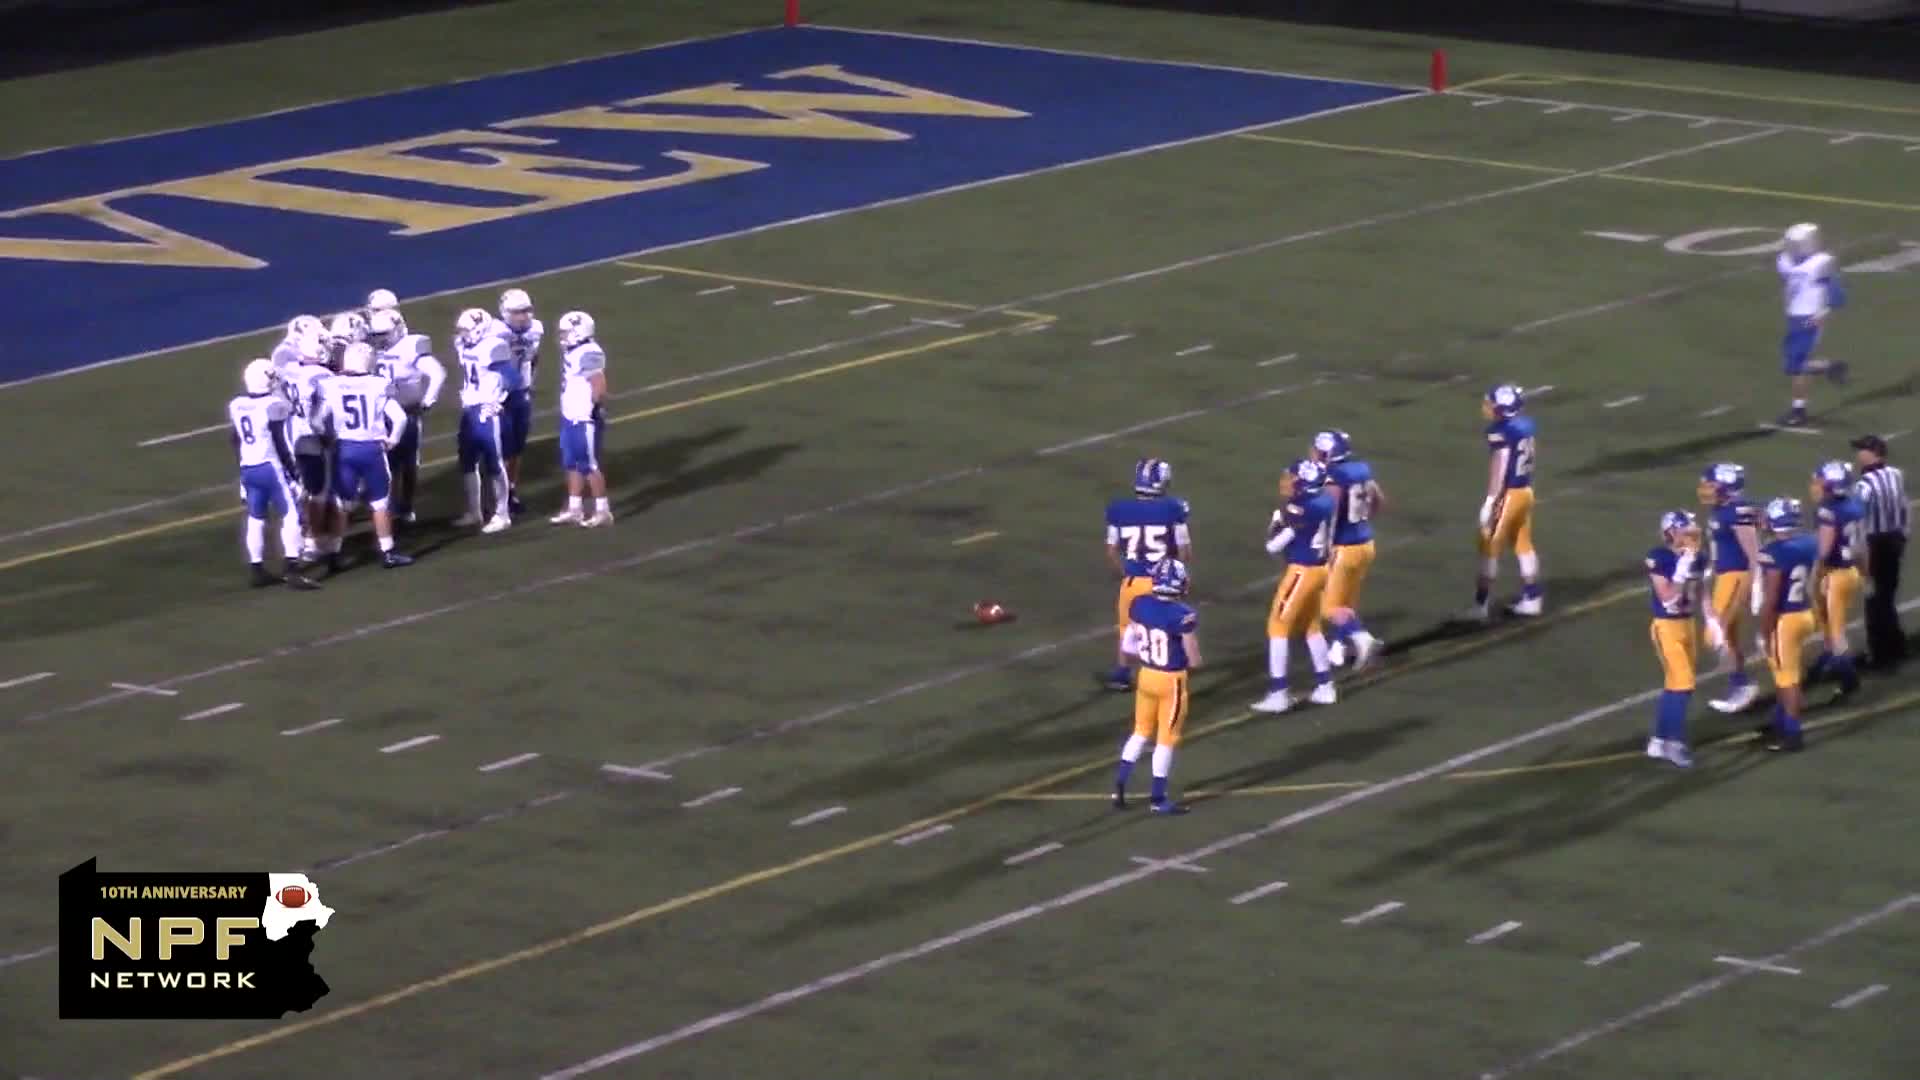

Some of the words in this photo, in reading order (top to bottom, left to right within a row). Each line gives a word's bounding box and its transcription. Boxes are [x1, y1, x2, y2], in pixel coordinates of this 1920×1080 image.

[0, 63, 1031, 270] VIEW
[240, 415, 255, 445] 8
[341, 394, 370, 430] 51
[1119, 525, 1169, 561] 75
[1136, 624, 1169, 657] 20
